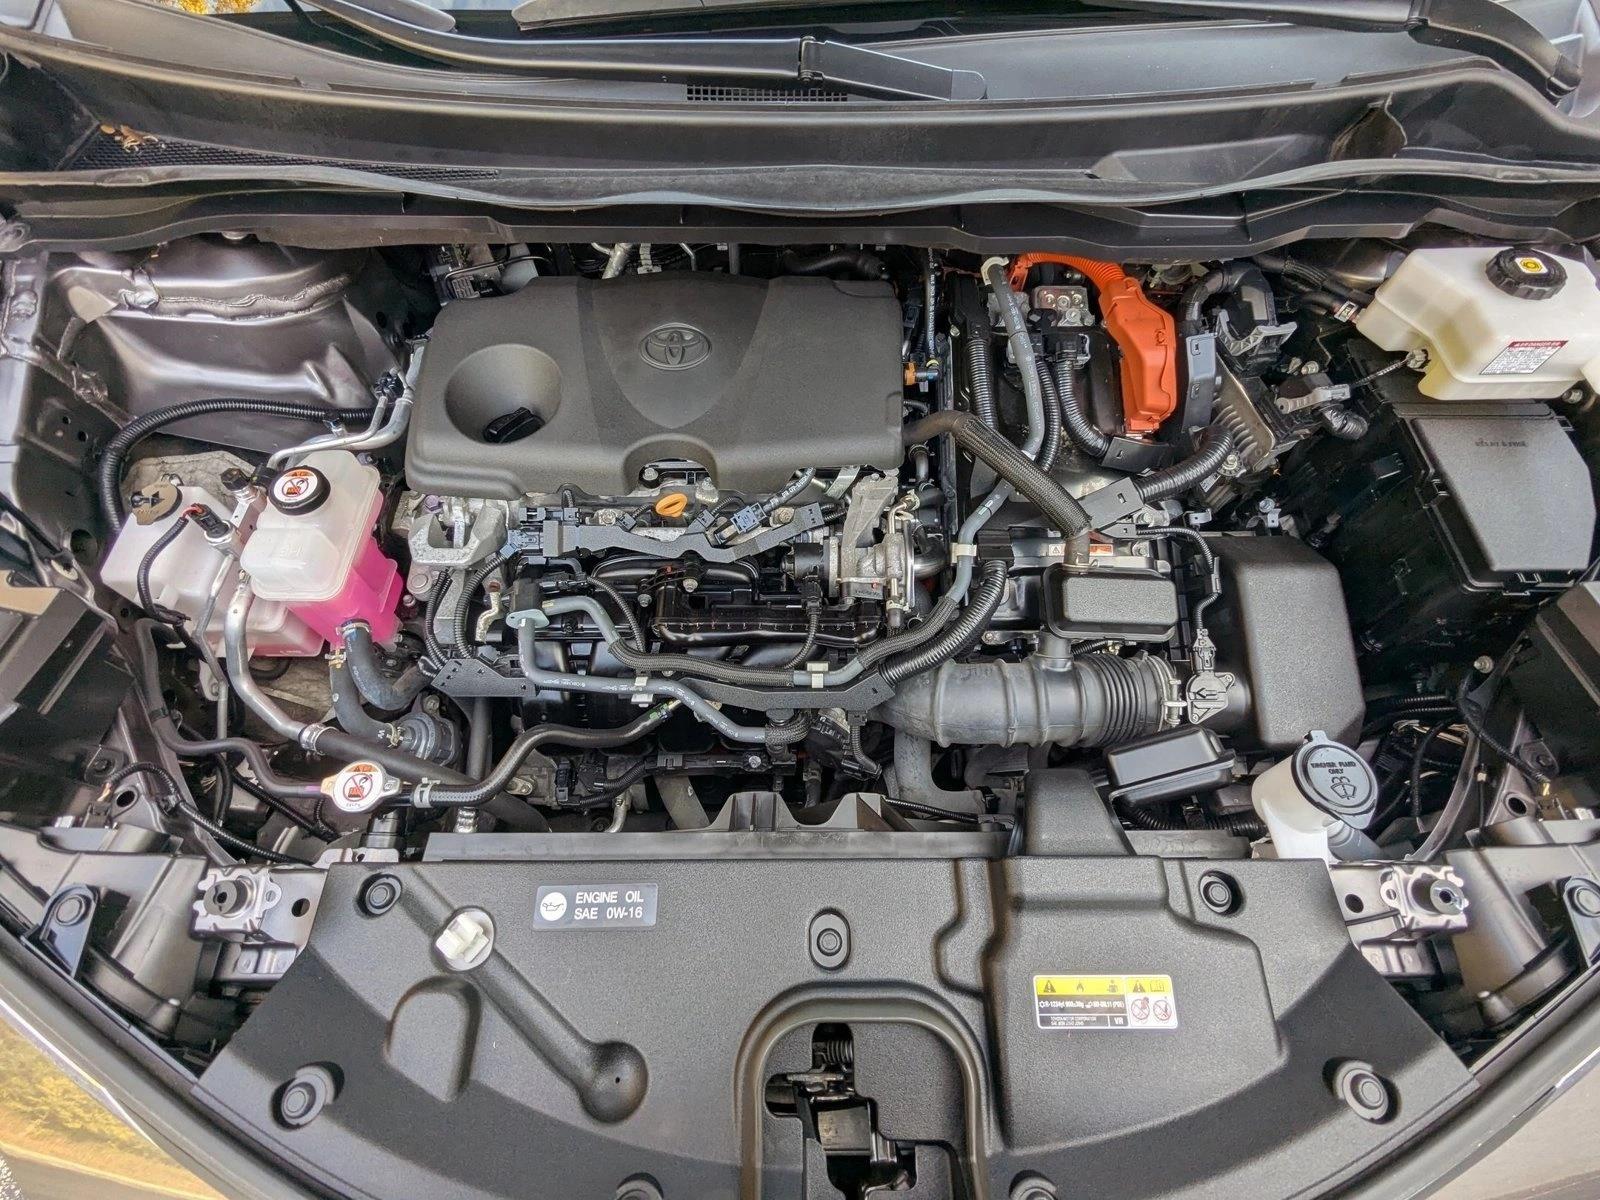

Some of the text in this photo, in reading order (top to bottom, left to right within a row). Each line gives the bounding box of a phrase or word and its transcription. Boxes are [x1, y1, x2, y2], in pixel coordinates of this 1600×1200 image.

[576, 890, 644, 903] ENGINE OIL
[574, 906, 643, 919] SAE 0W-16
